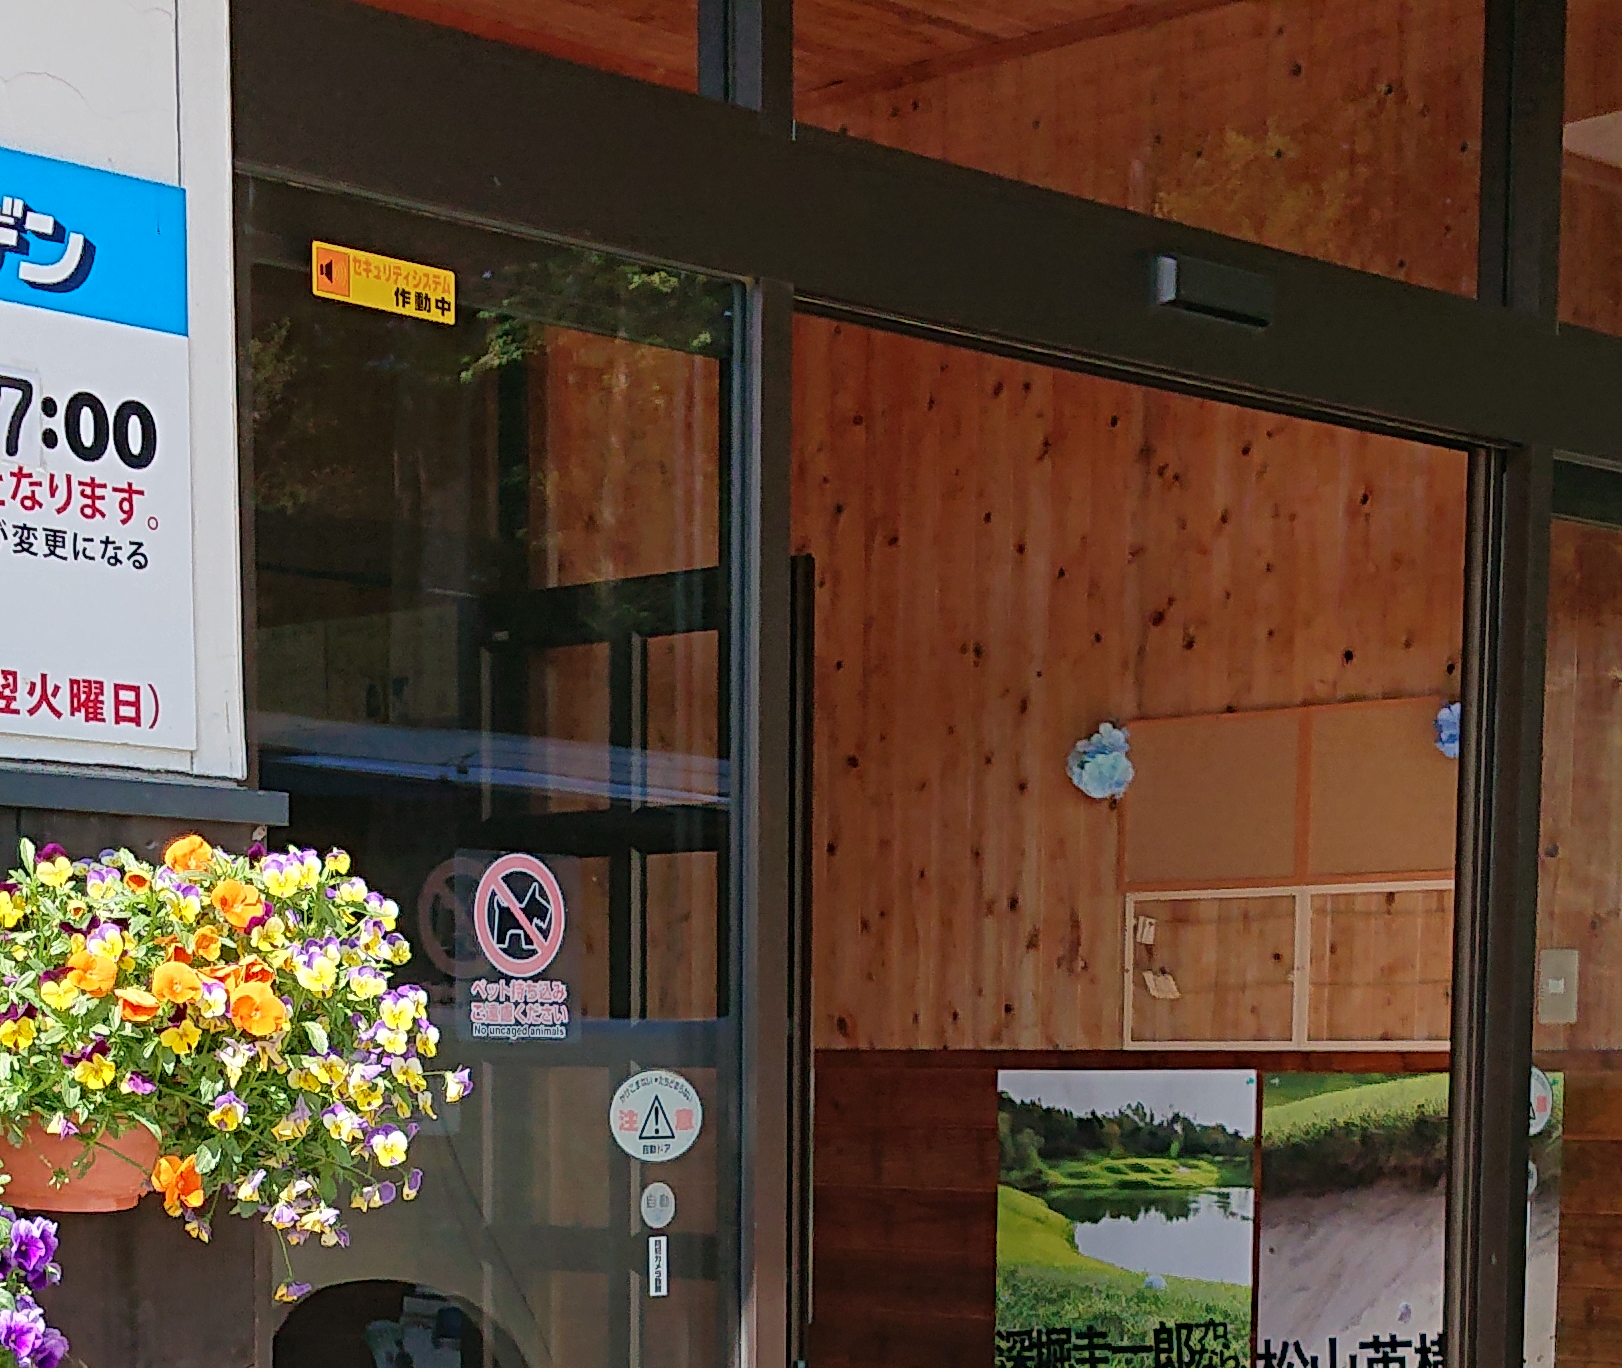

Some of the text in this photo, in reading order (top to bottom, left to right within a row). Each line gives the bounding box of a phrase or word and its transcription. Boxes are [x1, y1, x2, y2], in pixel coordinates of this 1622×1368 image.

[352, 256, 451, 295] セキュリティシステム
[394, 287, 452, 316] 作動中
[471, 979, 567, 1002] ペット持ち込み
[471, 1002, 569, 1024] ご遠慮ください
[474, 1023, 565, 1038] No uncaged animals
